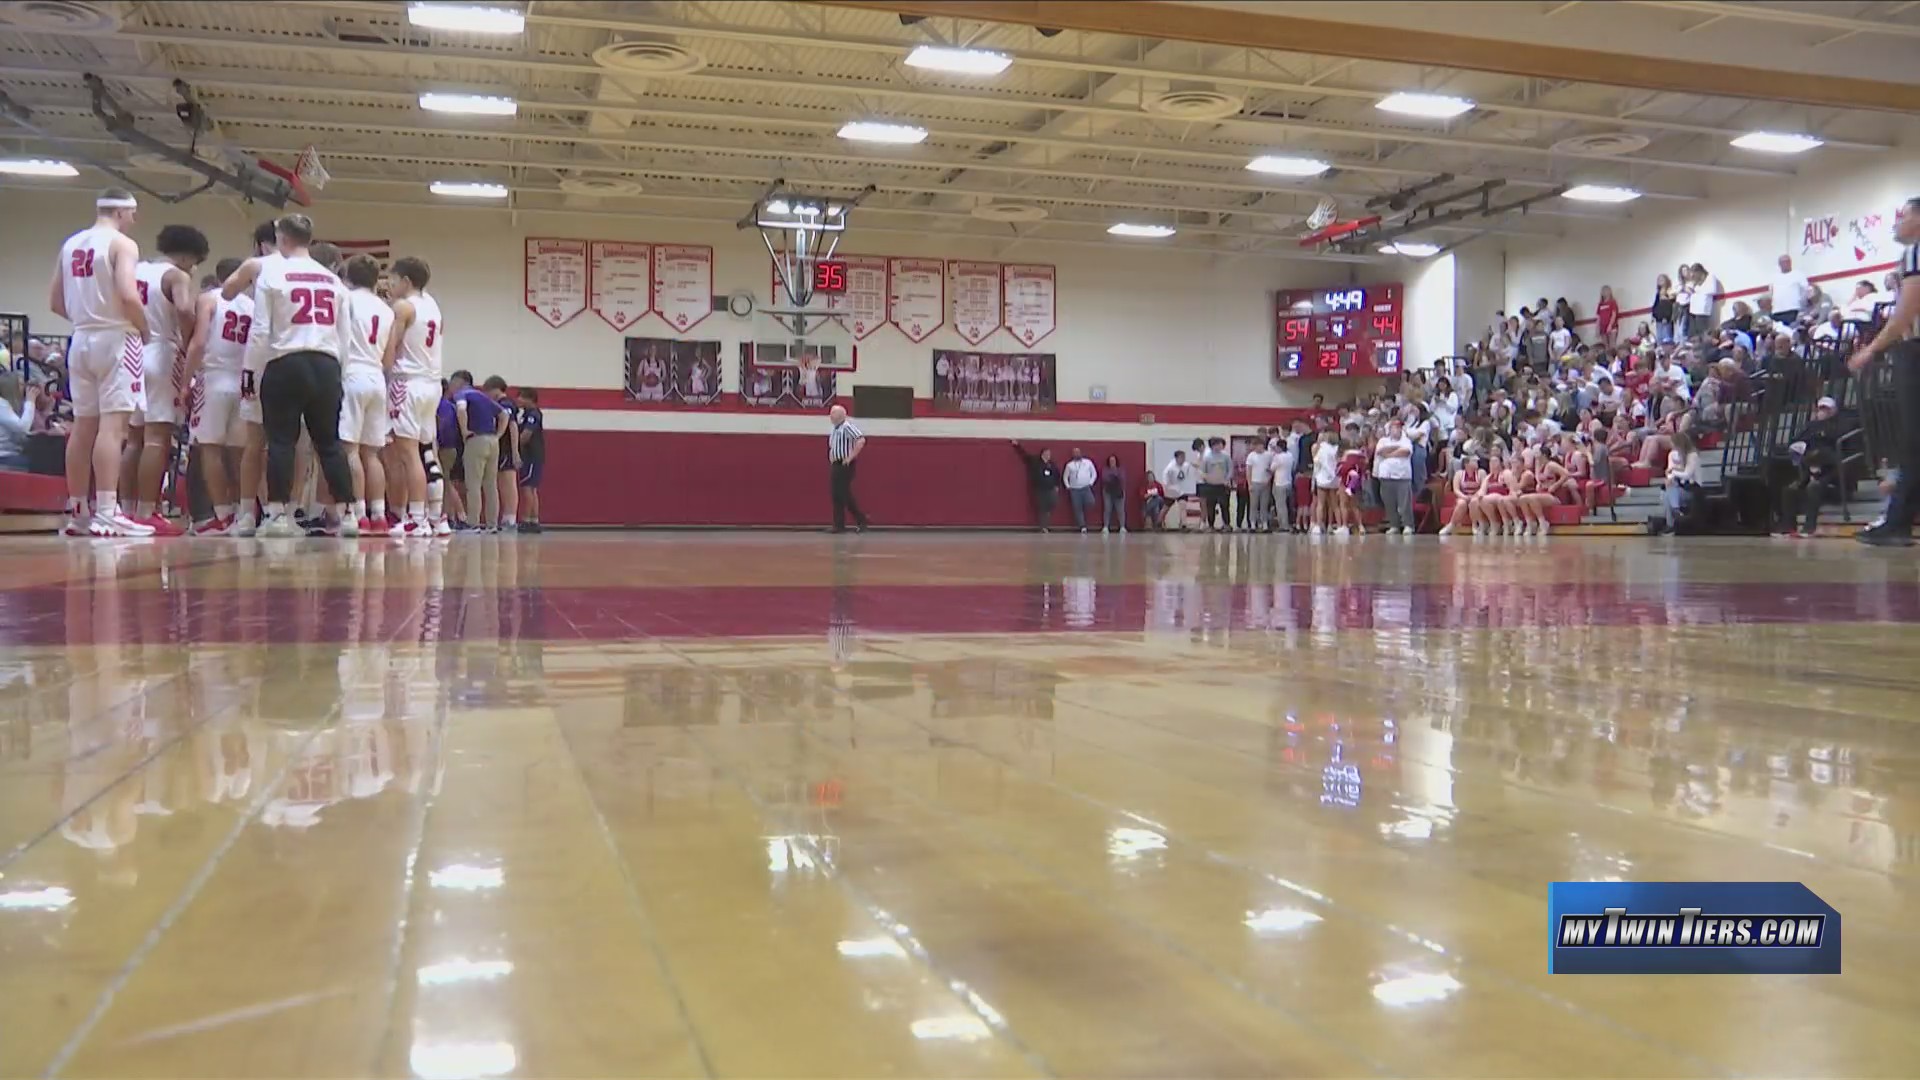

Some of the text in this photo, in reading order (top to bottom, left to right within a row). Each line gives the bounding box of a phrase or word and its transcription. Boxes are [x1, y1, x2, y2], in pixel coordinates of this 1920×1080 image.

[1804, 217, 1834, 246] ALLY
[815, 264, 844, 289] 35
[290, 287, 335, 326] 25
[1325, 289, 1363, 311] 4:49
[222, 310, 252, 344] 23
[368, 315, 380, 345] 1
[425, 320, 436, 348] 3
[1286, 319, 1309, 340] 54
[1333, 324, 1343, 337] 4
[1374, 316, 1396, 335] 44
[1289, 354, 1298, 369] 2
[1320, 351, 1339, 368] 23
[1387, 350, 1397, 365] 0
